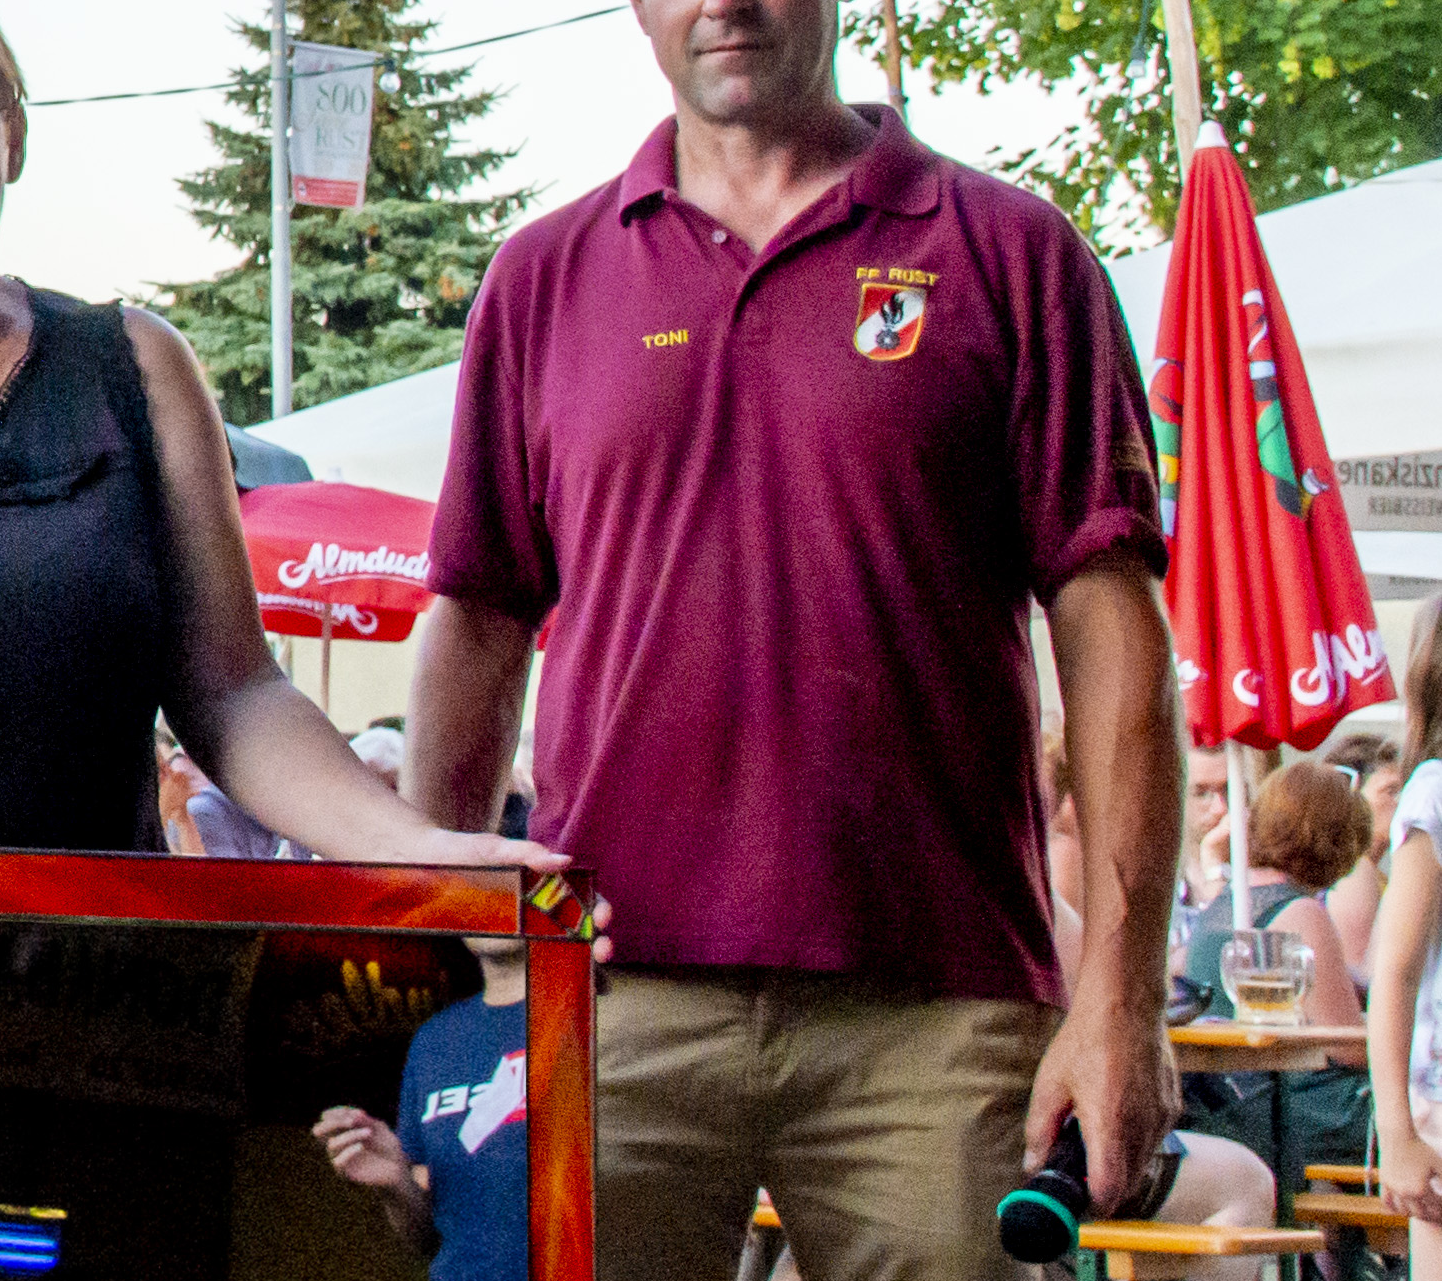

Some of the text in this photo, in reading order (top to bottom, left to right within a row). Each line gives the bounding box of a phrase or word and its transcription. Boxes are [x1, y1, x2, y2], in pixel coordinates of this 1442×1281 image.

[315, 81, 368, 116] 800
[856, 266, 939, 286] FF RUST
[642, 329, 688, 348] TONI
